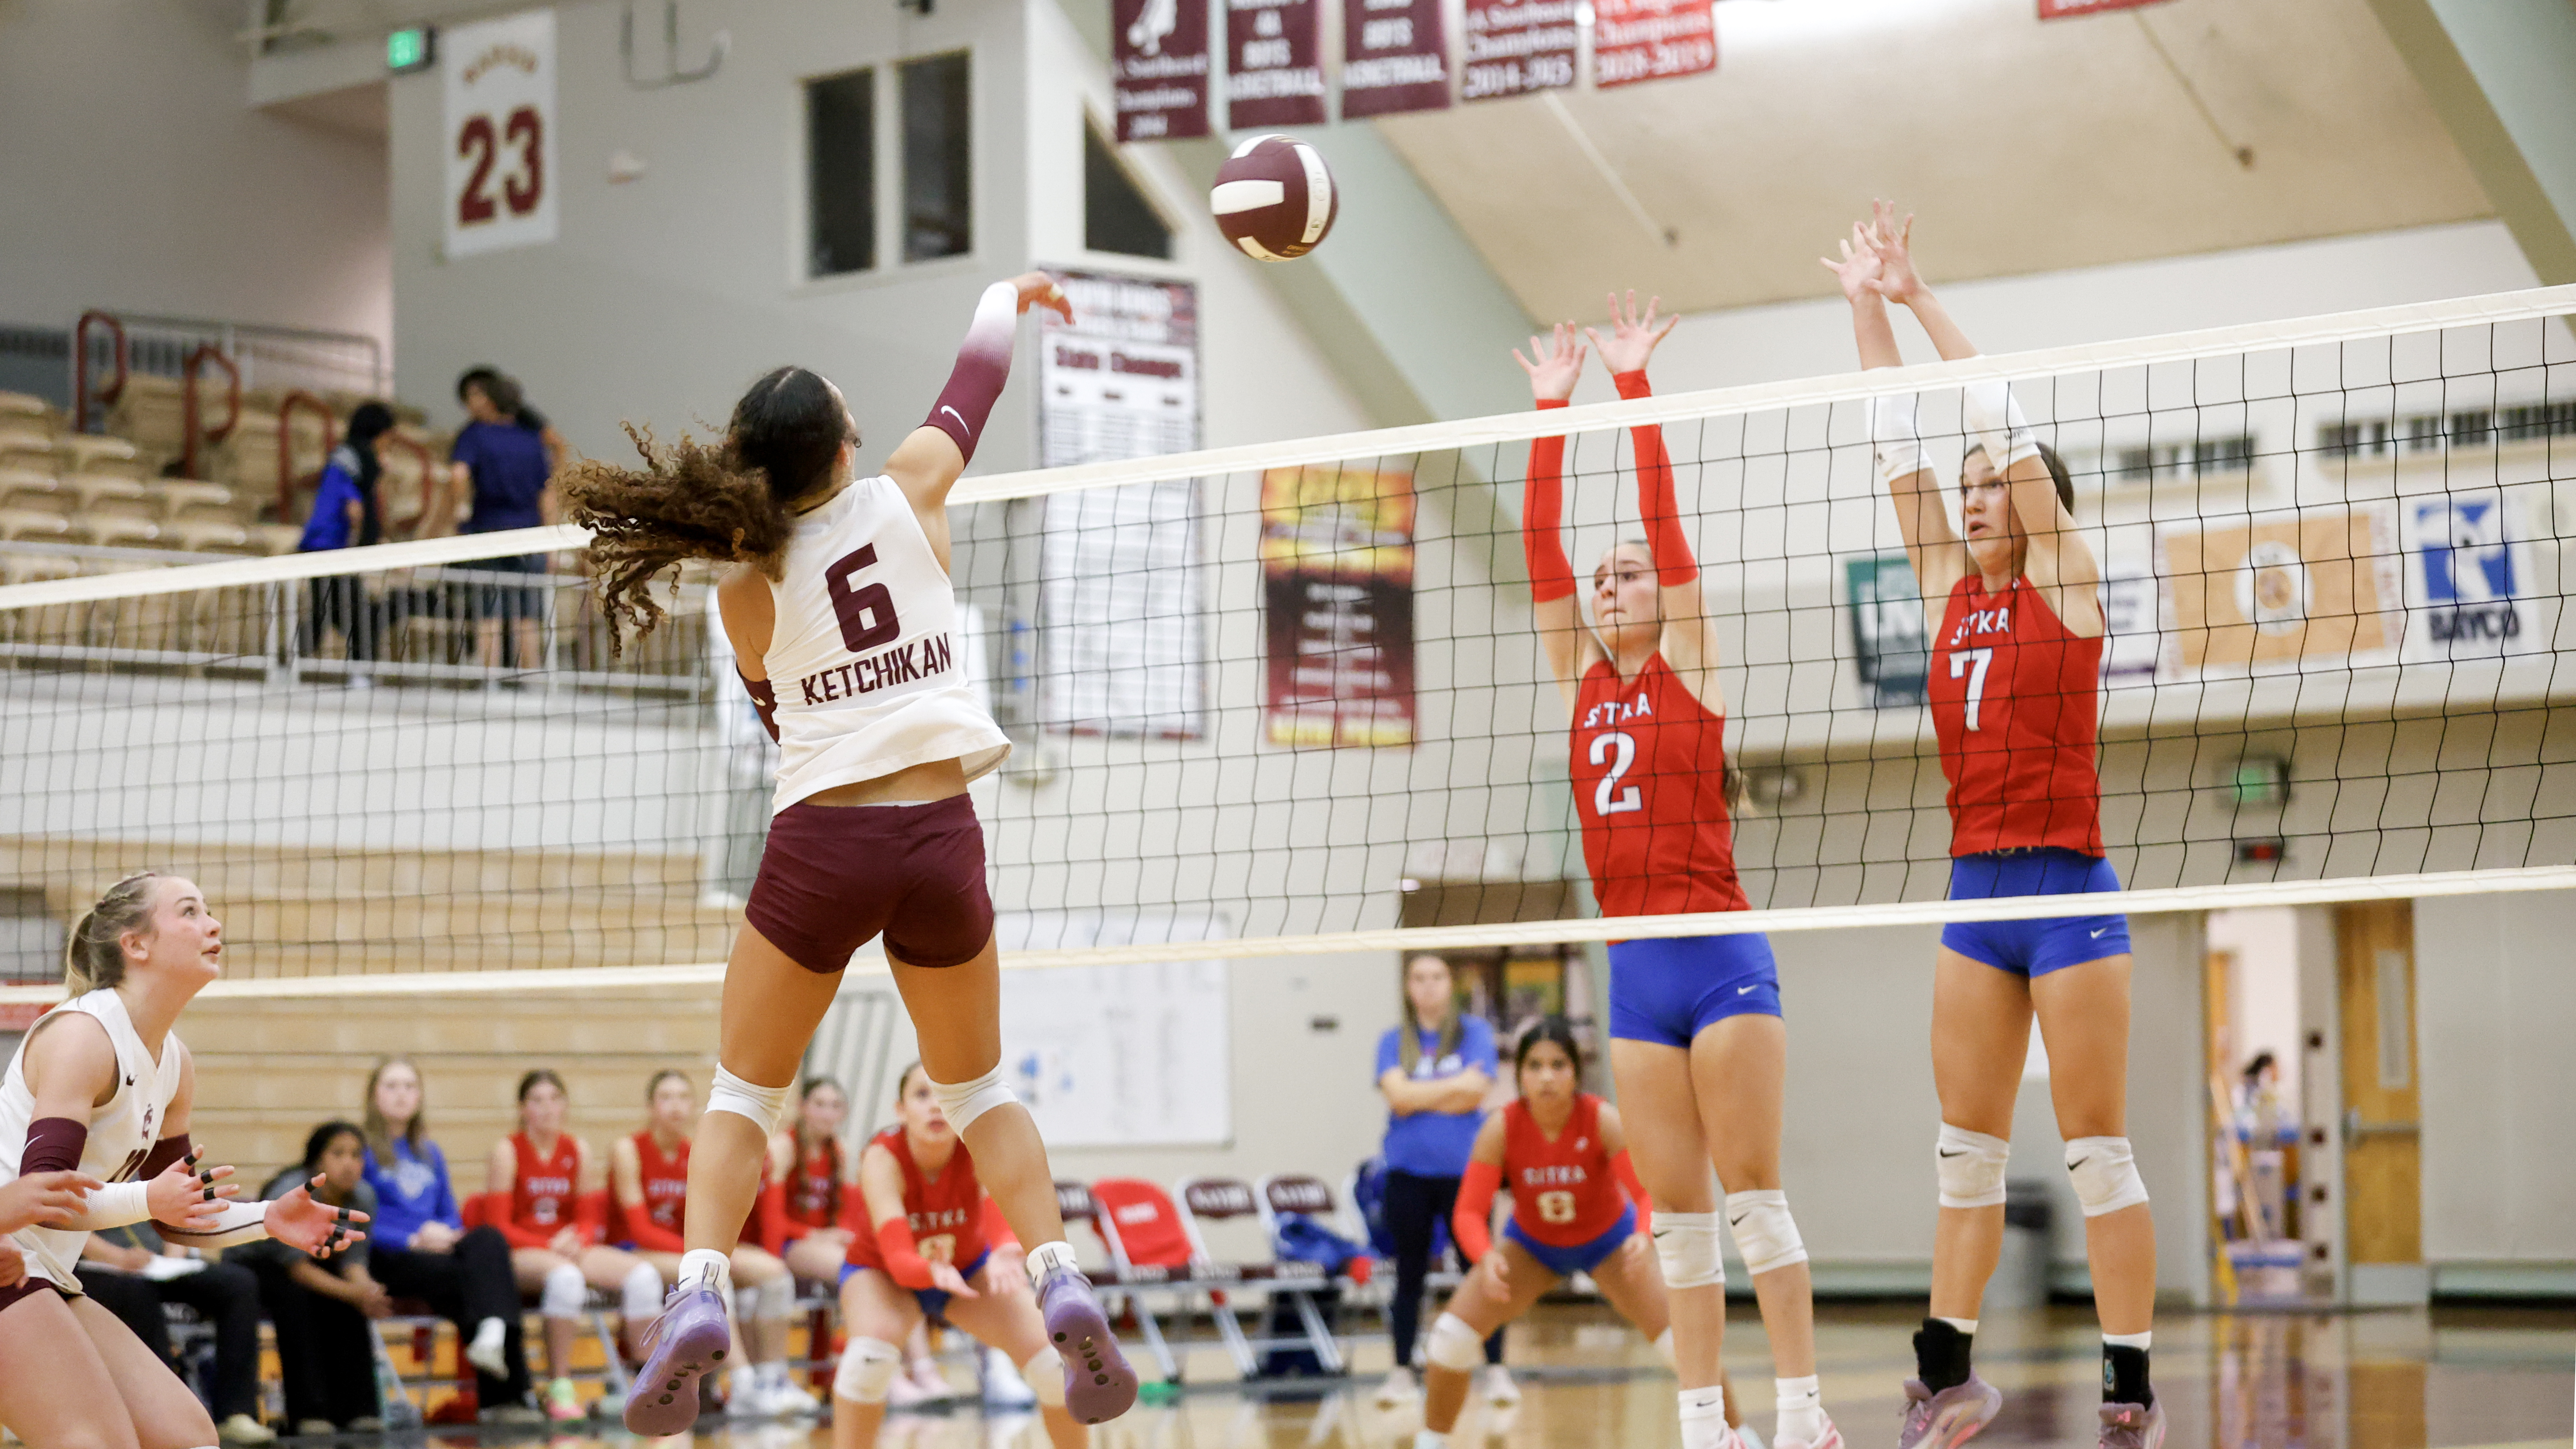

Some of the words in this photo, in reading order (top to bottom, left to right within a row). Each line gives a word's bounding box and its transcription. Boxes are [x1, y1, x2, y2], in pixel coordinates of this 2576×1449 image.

[457, 106, 544, 228] 23
[825, 542, 900, 653] 6
[801, 632, 951, 706] KETCHIKAN
[1949, 648, 1993, 732] 7
[1589, 731, 1642, 817] 2
